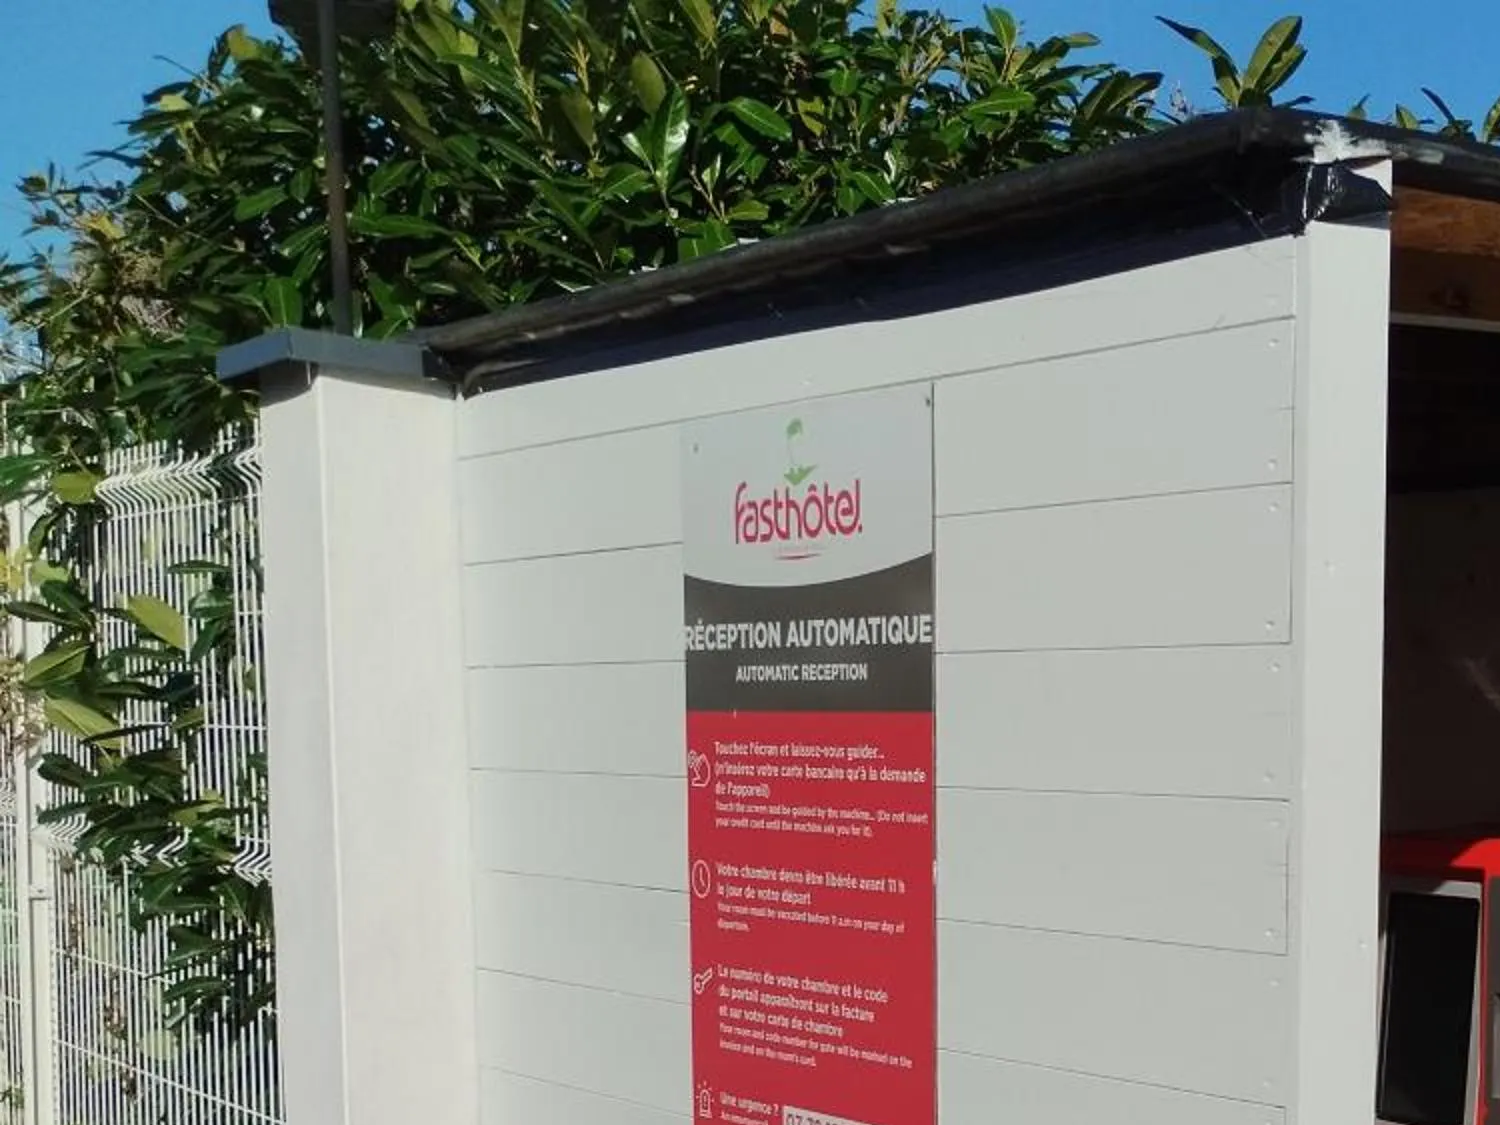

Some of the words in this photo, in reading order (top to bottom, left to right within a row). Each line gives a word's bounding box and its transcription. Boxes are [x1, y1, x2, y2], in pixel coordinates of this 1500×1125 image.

[685, 619, 781, 651] RÉCEPTION
[786, 614, 932, 648] AUTOMATIQUE
[736, 664, 799, 682] AUTOMATIC
[801, 663, 867, 681] RECEPTION
[714, 741, 748, 756] Touchez
[780, 743, 788, 757] et
[756, 764, 779, 777] votre
[780, 765, 804, 779] carte
[805, 763, 844, 780] bancaire
[868, 765, 878, 781] la
[879, 765, 927, 783] demande
[715, 781, 726, 796] de
[715, 862, 739, 877] Votre
[739, 864, 777, 881] chambre
[859, 876, 886, 892] avant
[716, 882, 725, 896] le
[725, 883, 743, 899] jour
[743, 884, 756, 899] de
[757, 888, 780, 902] votre
[717, 963, 729, 978] Le
[763, 971, 775, 985] de
[776, 975, 799, 989] votre
[800, 976, 840, 996] chambre
[841, 983, 852, 998] et
[853, 983, 863, 1000] le
[863, 988, 889, 1003] code
[719, 1004, 729, 1017] et
[743, 1009, 766, 1024] votre
[791, 1016, 803, 1031] de
[814, 1000, 829, 1015] sur
